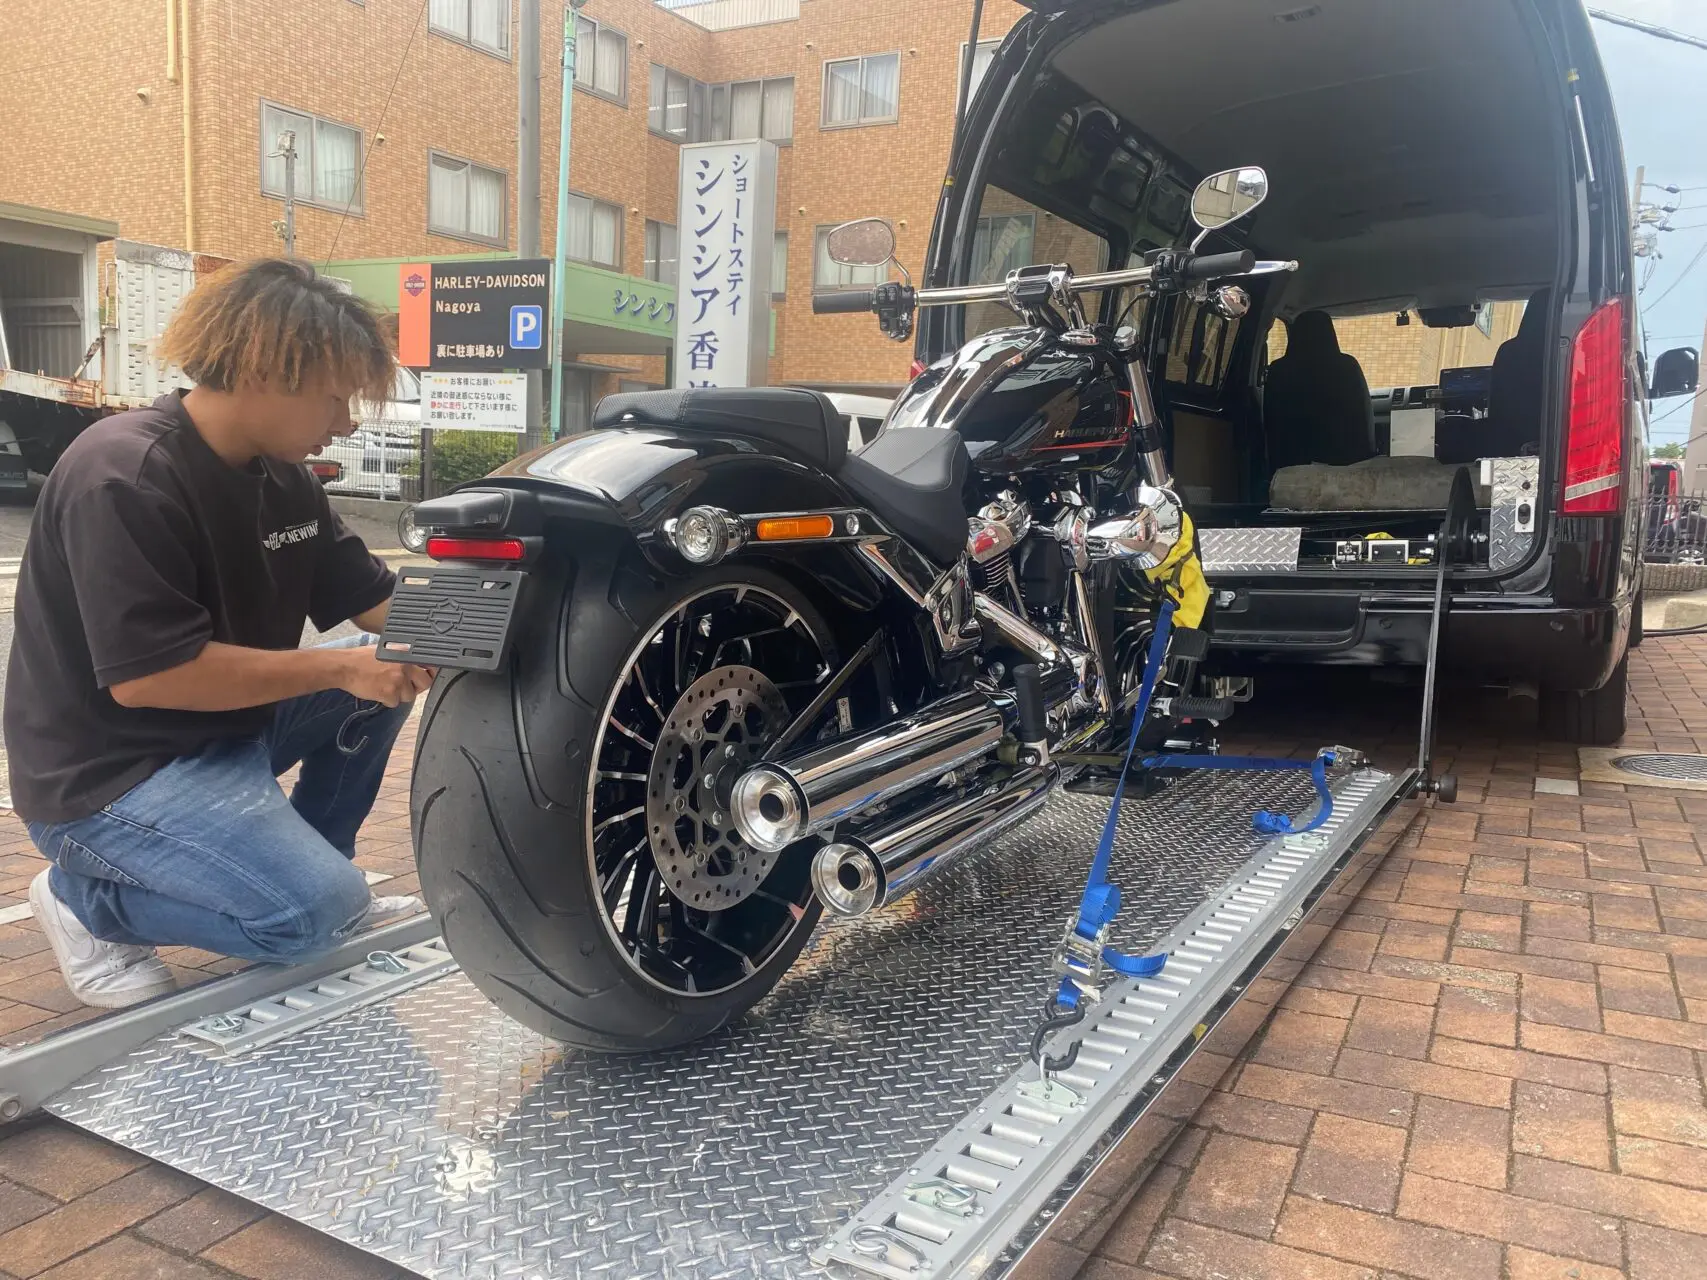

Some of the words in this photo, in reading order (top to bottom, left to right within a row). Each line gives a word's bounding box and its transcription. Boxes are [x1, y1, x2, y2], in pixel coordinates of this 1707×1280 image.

[725, 154, 749, 317] ショートステイ
[687, 159, 725, 388] シンシア香
[434, 274, 546, 289] HARLEY-DAVIDSON
[435, 300, 481, 314] Nagoya
[516, 312, 537, 341] P
[436, 344, 505, 358] 裏に駐車場あり
[450, 377, 496, 386] お客様にお願い
